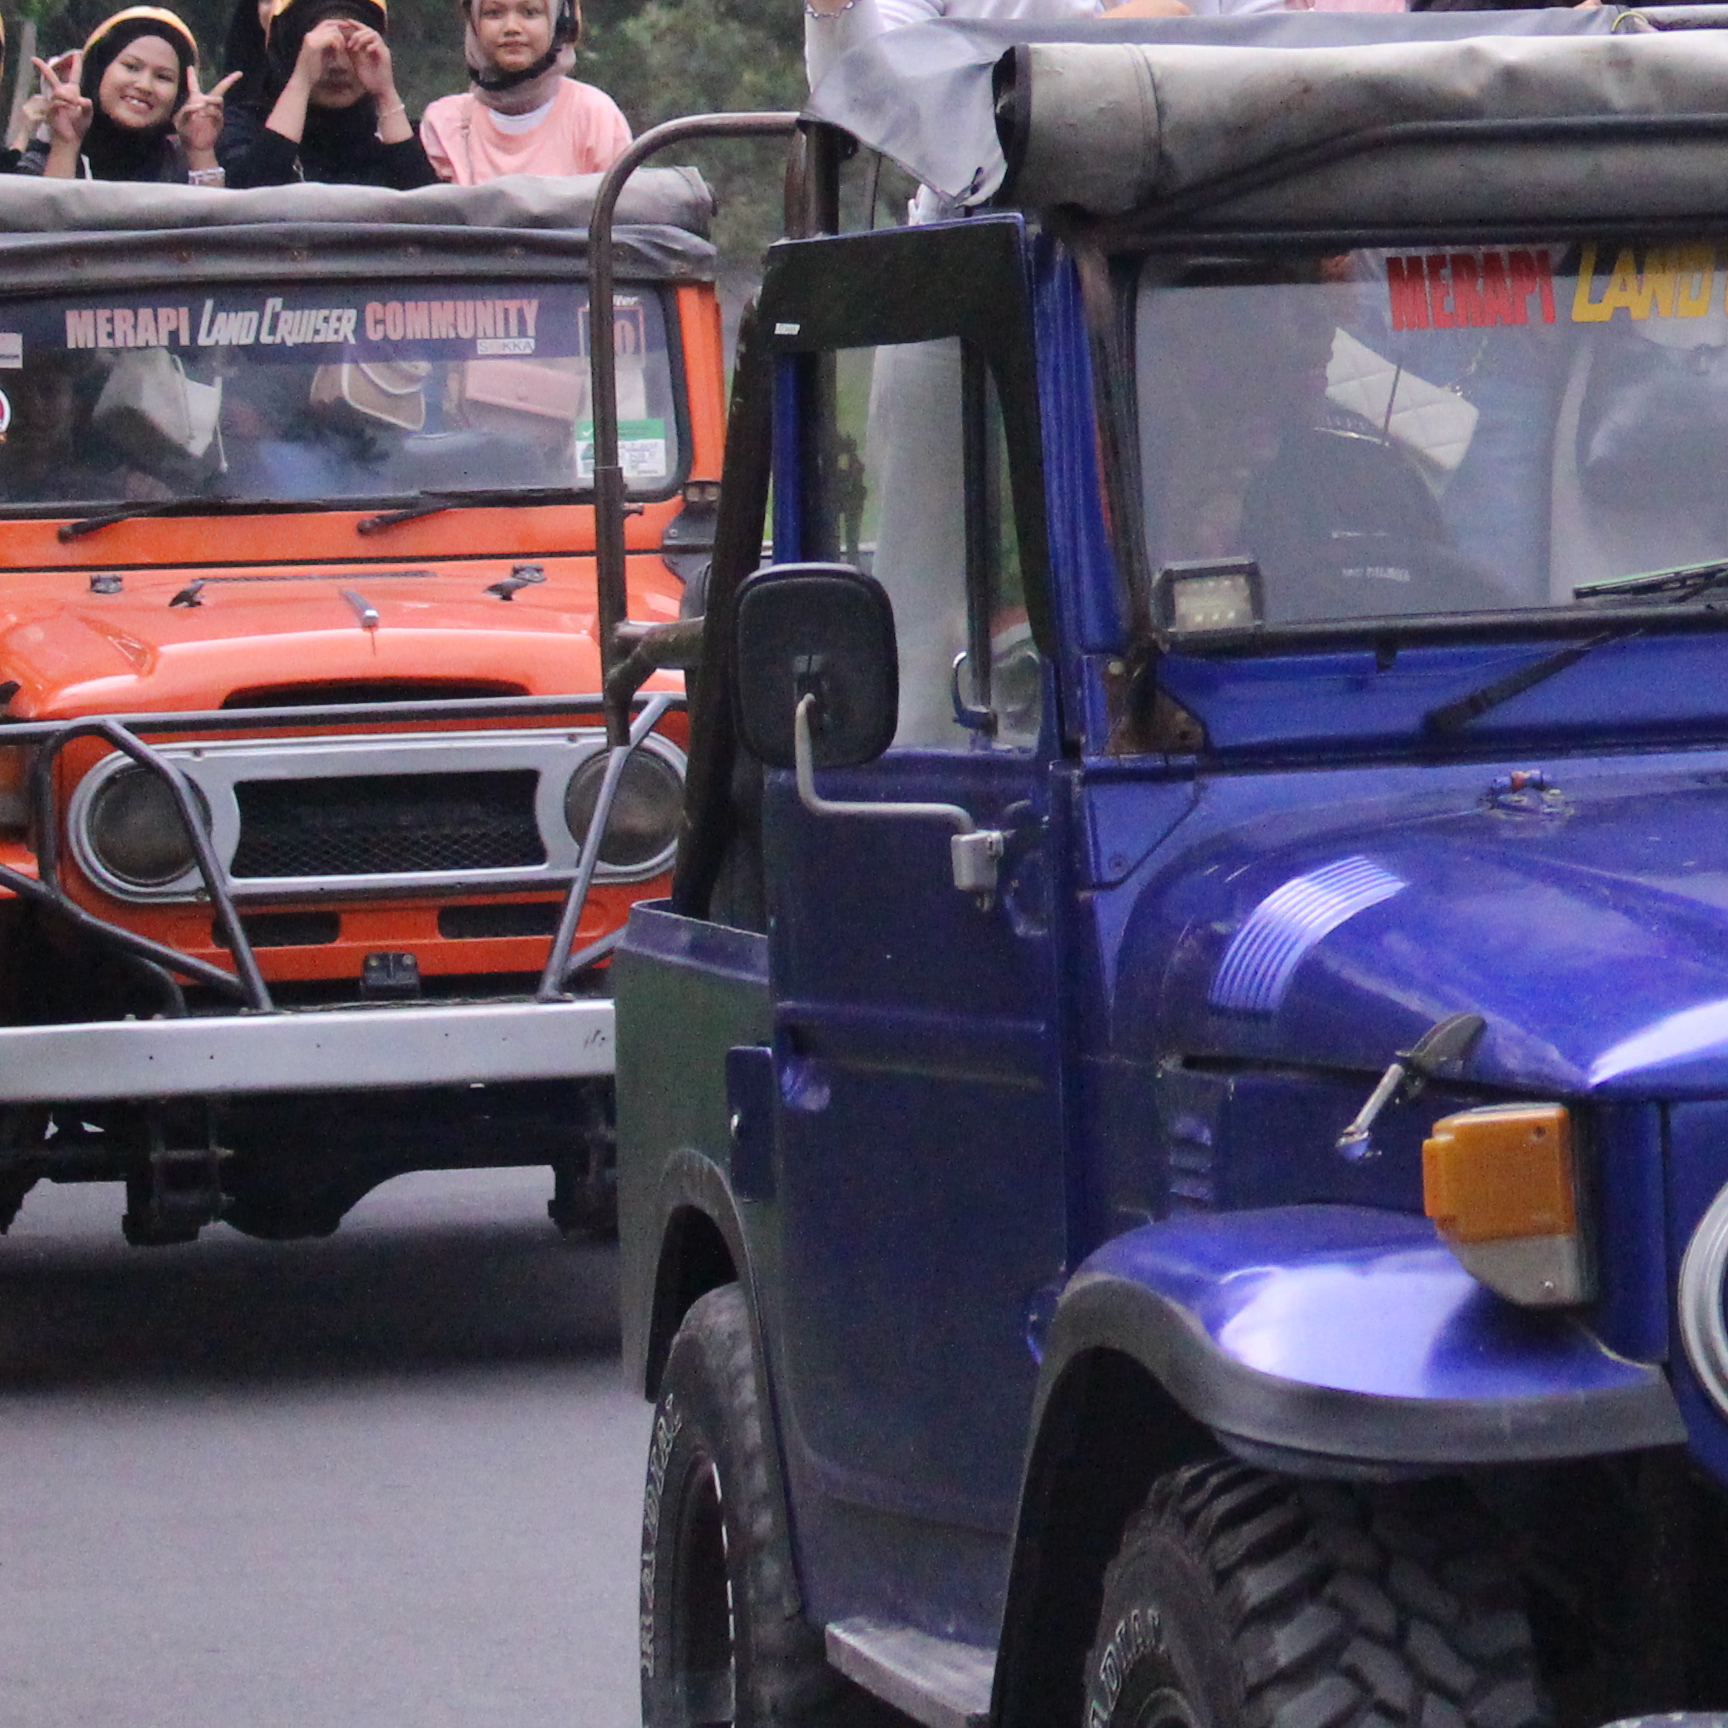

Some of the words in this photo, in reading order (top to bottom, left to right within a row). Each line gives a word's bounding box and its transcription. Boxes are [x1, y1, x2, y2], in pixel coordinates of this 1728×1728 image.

[1386, 249, 1555, 330] MERAPI
[1571, 237, 1717, 322] LAND
[65, 307, 190, 349] MERAPI
[365, 299, 539, 341] COMMUNITY
[479, 341, 534, 353] SKKA
